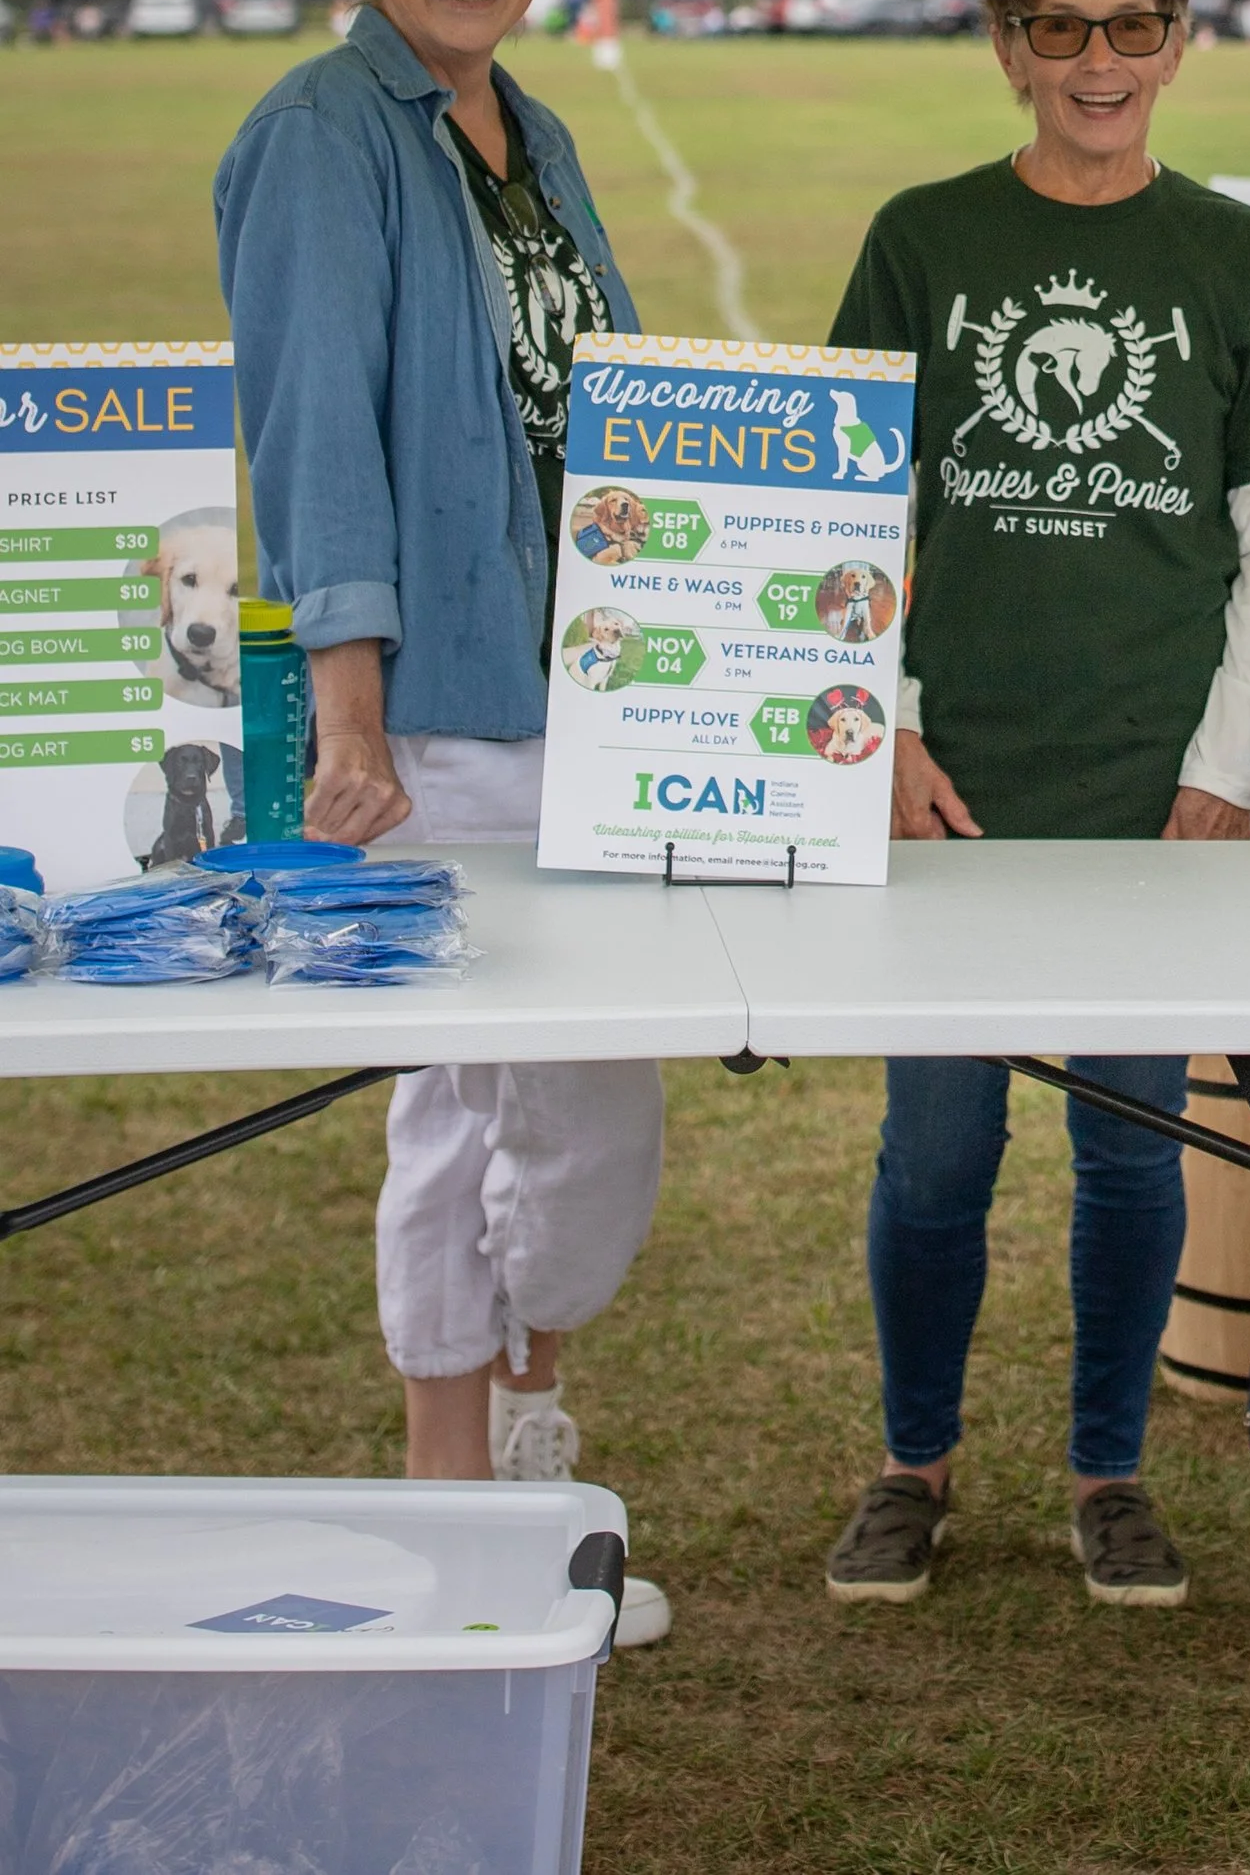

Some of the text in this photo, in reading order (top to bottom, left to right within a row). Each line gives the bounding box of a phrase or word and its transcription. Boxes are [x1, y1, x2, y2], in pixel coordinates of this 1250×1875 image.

[582, 366, 815, 428] Upcoming
[55, 387, 194, 433] SALE
[603, 418, 817, 473] EVENTS
[8, 491, 117, 506] PRICE LIST
[1046, 463, 1080, 502] &
[1088, 462, 1194, 516] Ponies
[652, 512, 701, 530] SEPT
[724, 515, 900, 540] PUPPIES & PONIES
[994, 517, 1108, 538] AT SUNSET
[0, 533, 148, 553] SHIRT $30
[662, 531, 688, 549] 08
[720, 540, 747, 550] 6 PM
[0, 584, 149, 604] AGNET $10
[610, 573, 743, 596] WINE & WAGS
[767, 583, 812, 602] OCT
[715, 601, 742, 611] 6 PM
[777, 603, 797, 621] 19
[31, 638, 88, 655] BOWL
[121, 635, 150, 651] $10
[646, 638, 694, 655] NOV
[721, 643, 875, 666] VETERANS GALA
[656, 657, 683, 674] 04
[724, 667, 752, 679] 5 PM
[0, 686, 152, 707] CK MAT $10
[622, 707, 739, 727] PUPPY LOVE
[761, 707, 800, 725] FEB
[692, 735, 738, 746] ALL DAY
[769, 726, 790, 744] 14
[31, 741, 68, 757] ART
[131, 737, 153, 753] $5
[633, 772, 766, 817] ICAN
[592, 823, 841, 848] Unleashing abilities for Hoosiers in need.
[602, 850, 618, 859] For
[648, 853, 705, 864] infomation,
[708, 856, 733, 864] email
